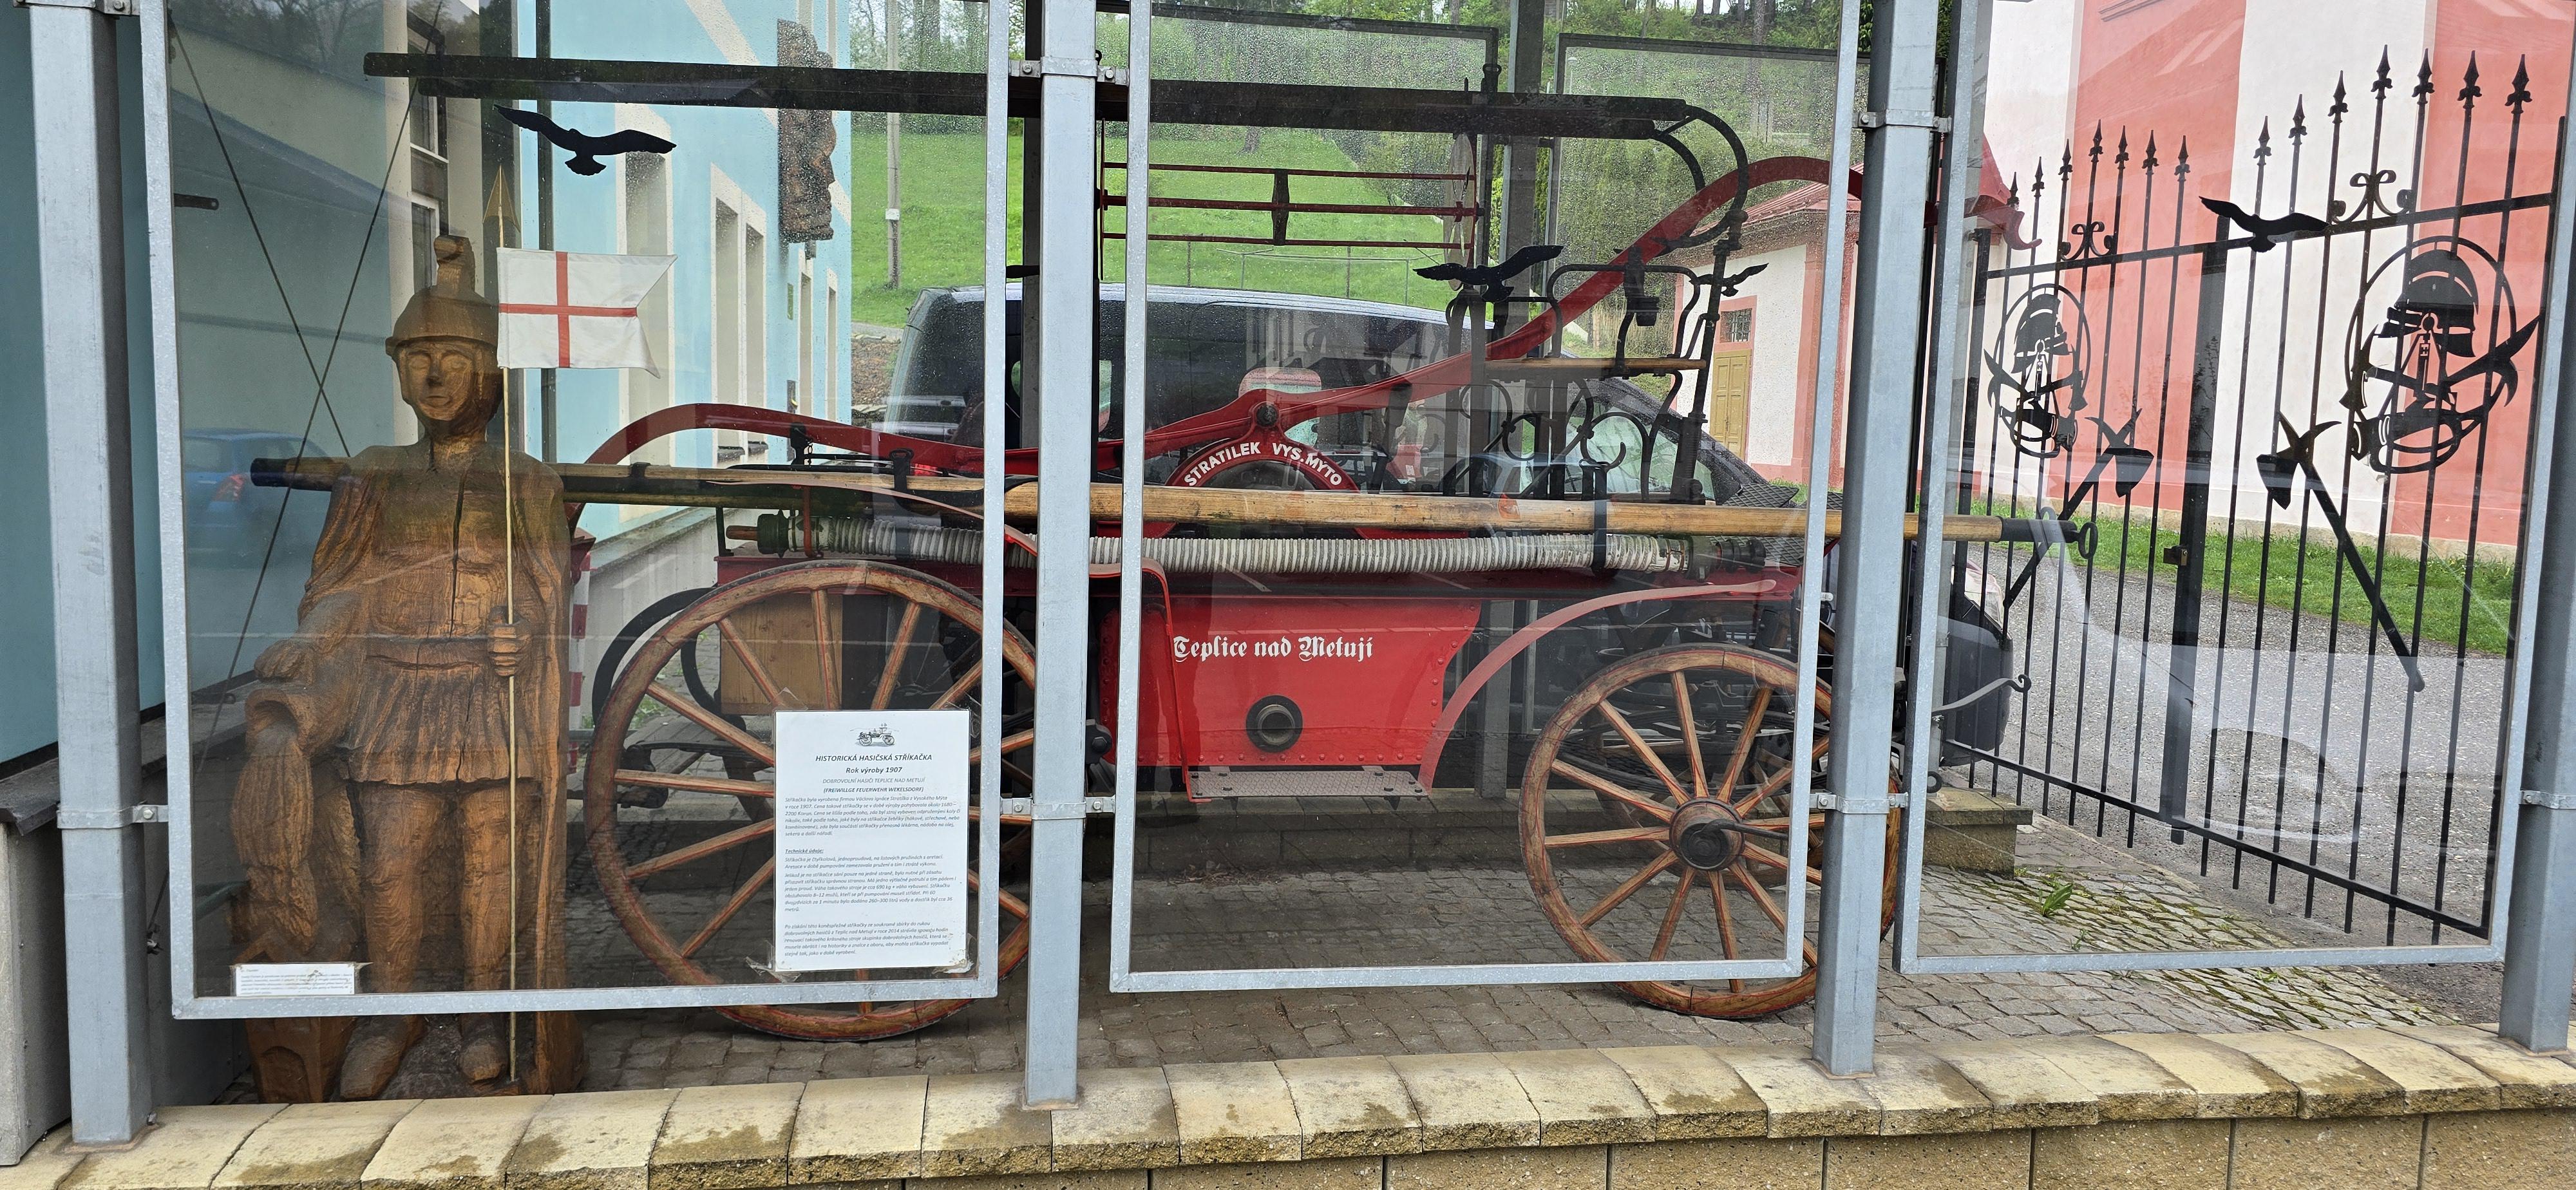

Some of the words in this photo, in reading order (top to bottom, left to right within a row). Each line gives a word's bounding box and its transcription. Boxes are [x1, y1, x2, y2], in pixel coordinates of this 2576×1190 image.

[1173, 635, 1247, 663] Teplice
[1254, 635, 1292, 657] nad
[1298, 635, 1373, 662] Metují
